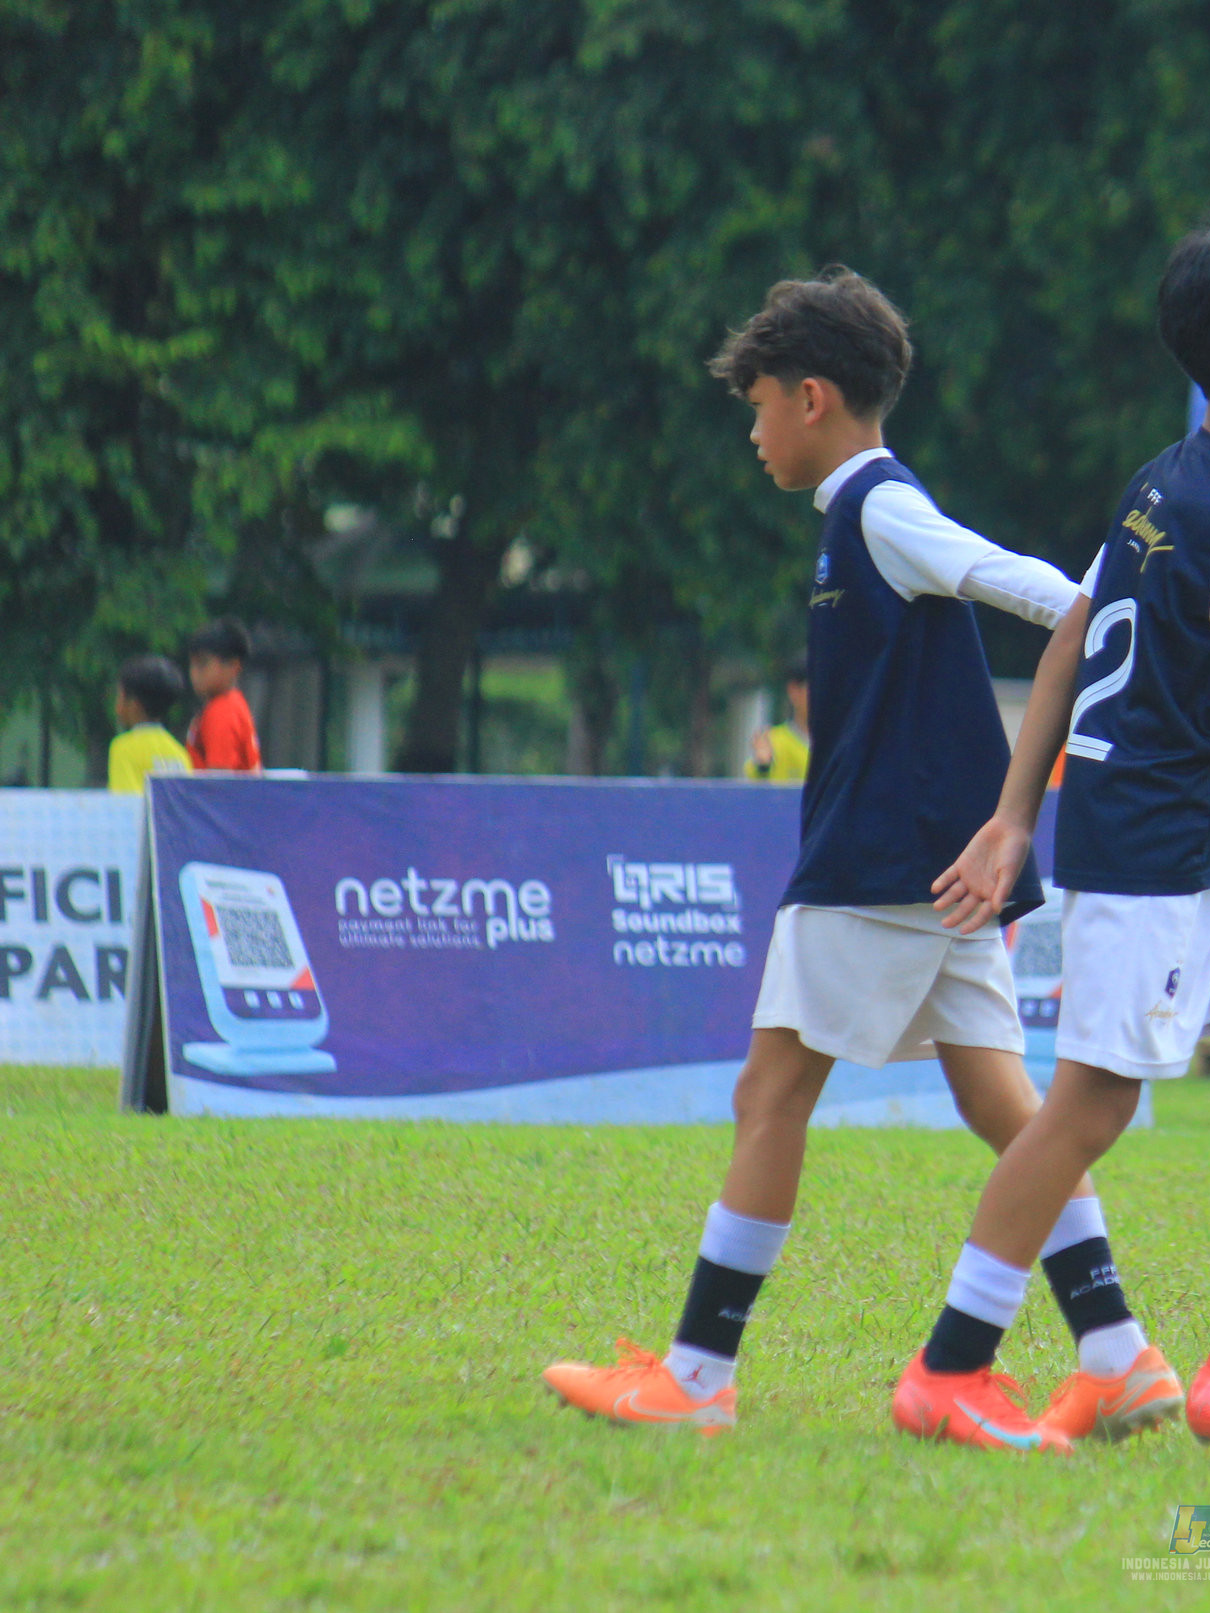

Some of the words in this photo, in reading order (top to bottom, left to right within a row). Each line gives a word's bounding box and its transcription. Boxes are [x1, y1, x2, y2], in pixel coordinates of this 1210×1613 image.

[1065, 597, 1137, 762] 2
[335, 867, 551, 918] netzme
[611, 861, 735, 911] QRIS
[487, 916, 555, 949] plus
[612, 934, 747, 968] netzme
